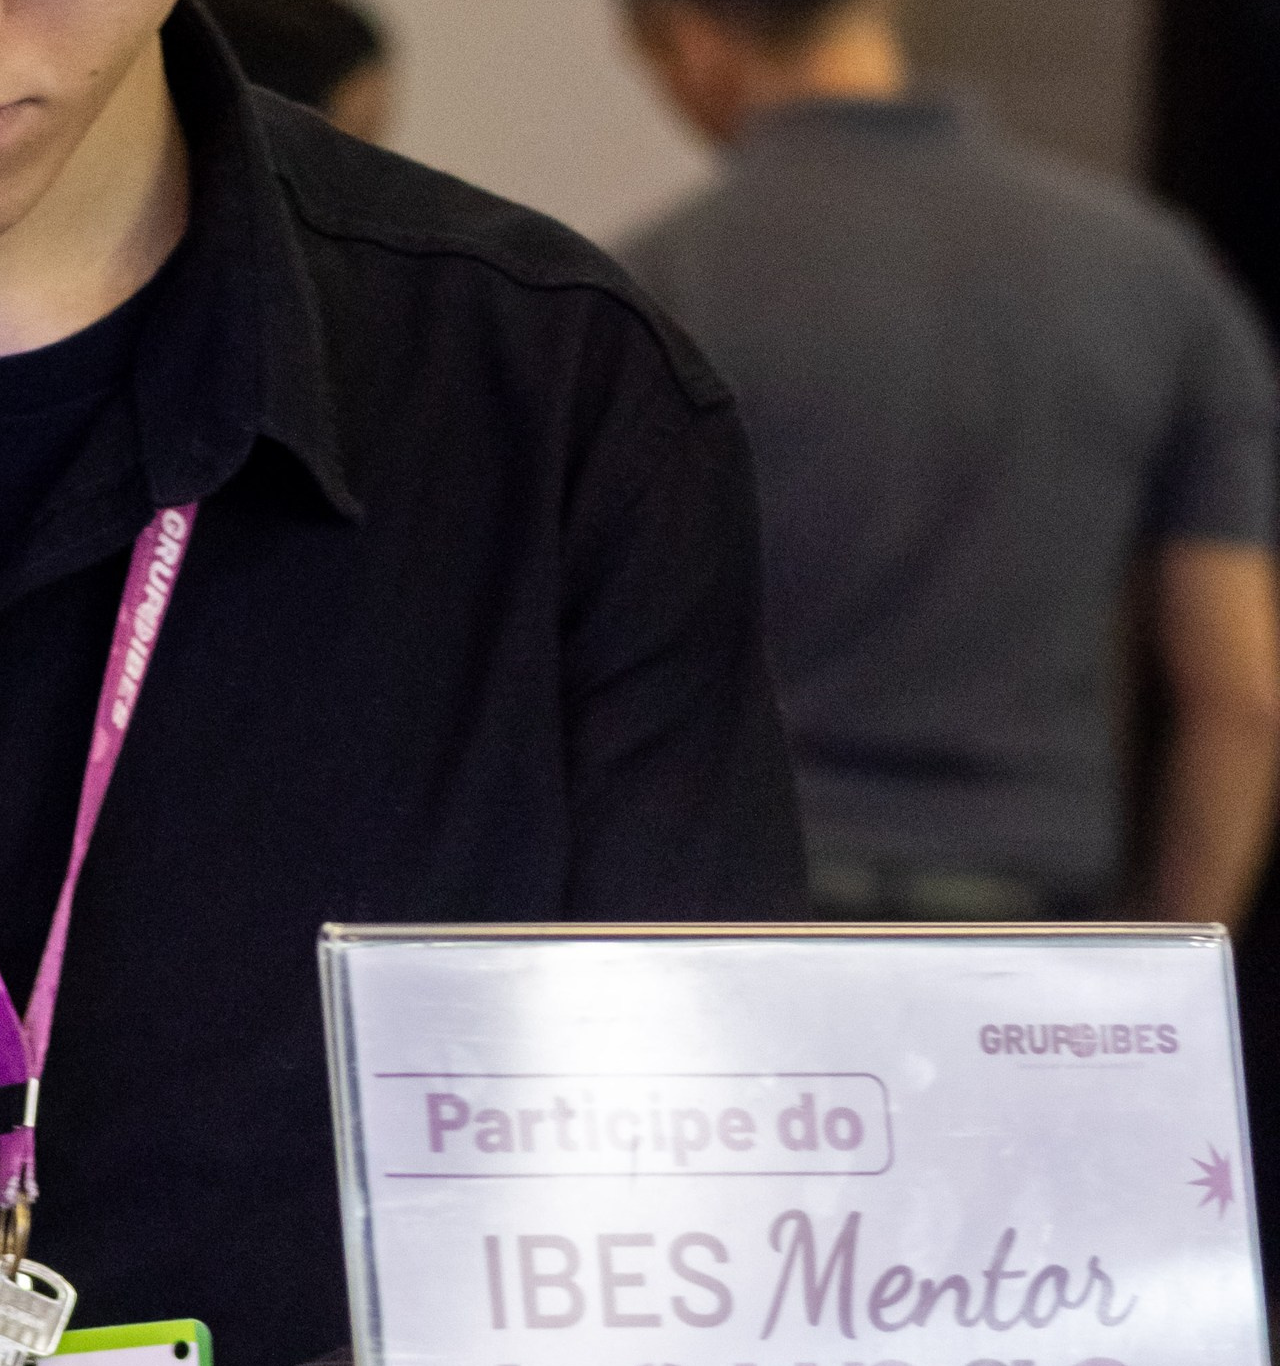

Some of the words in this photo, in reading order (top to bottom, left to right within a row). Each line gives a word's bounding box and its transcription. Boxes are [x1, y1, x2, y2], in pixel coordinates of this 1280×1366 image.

[425, 1088, 757, 1167] Participe
[776, 1092, 866, 1152] do
[483, 1232, 734, 1330] IBES
[759, 1209, 1138, 1339] Mentor
